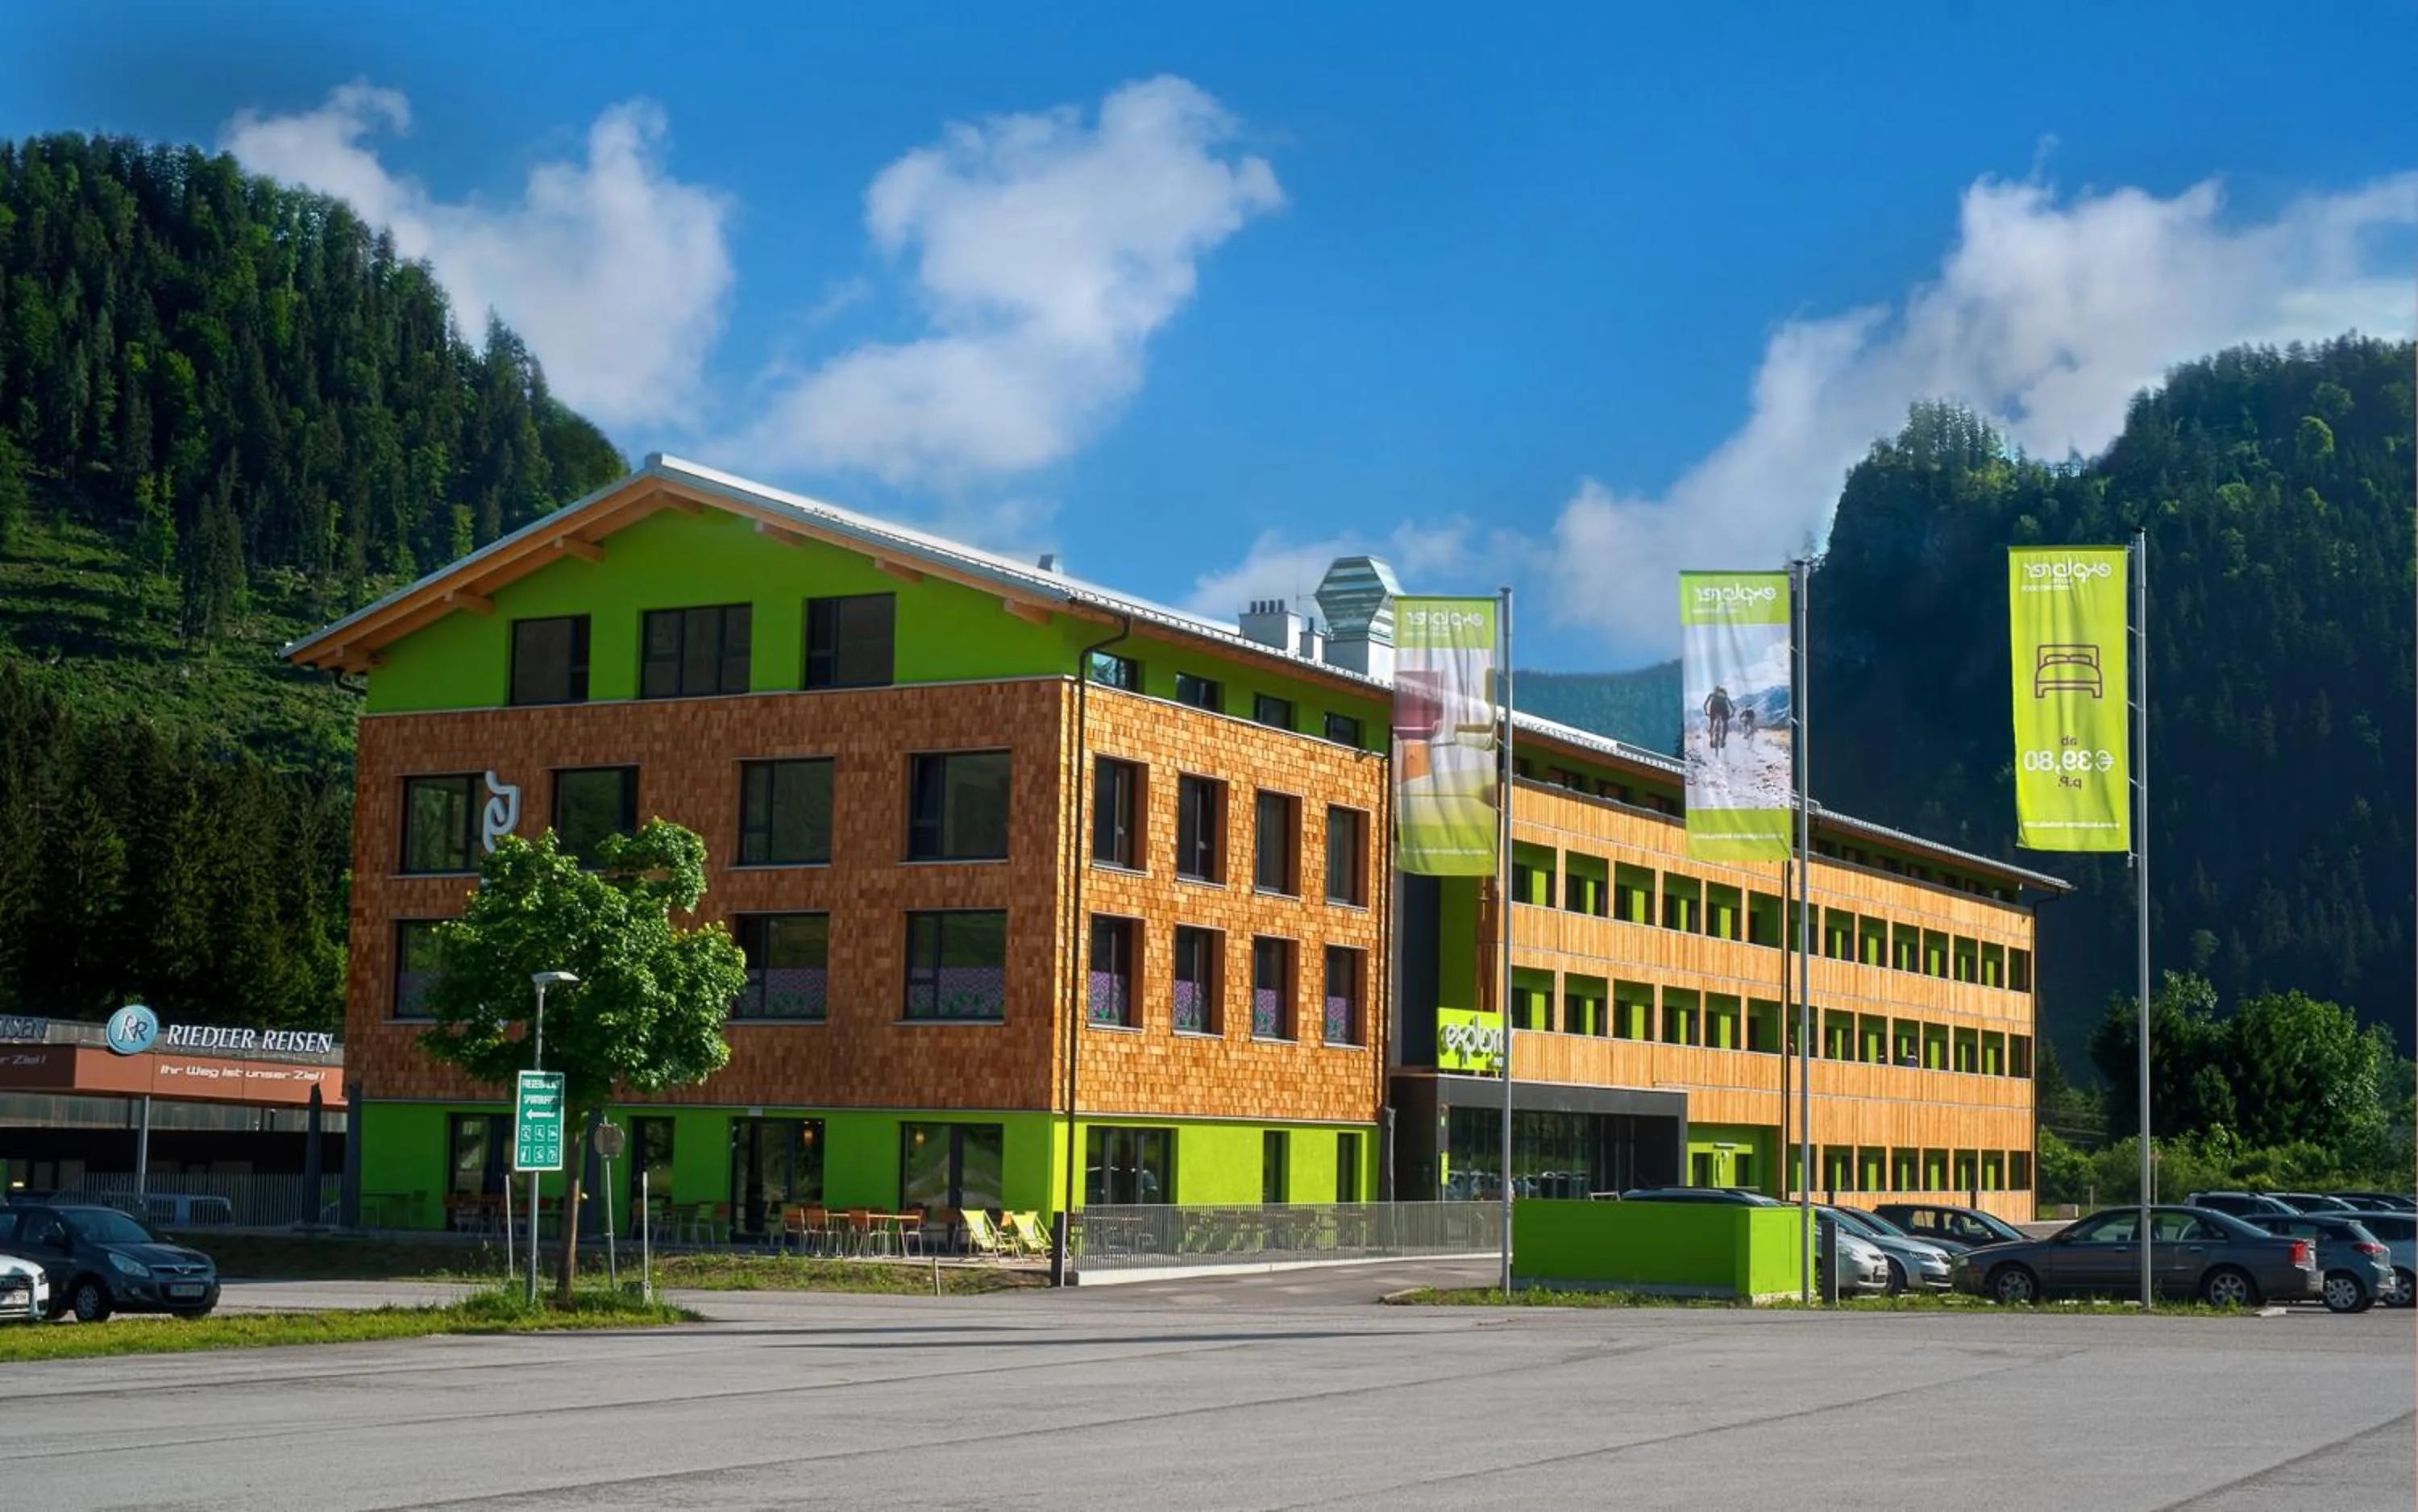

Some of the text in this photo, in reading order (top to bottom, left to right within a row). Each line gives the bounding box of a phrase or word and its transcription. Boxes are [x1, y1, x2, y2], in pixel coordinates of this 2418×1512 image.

[167, 1024, 334, 1054] RIEDLER REISEN
[1445, 1013, 1504, 1064] explor
[160, 1065, 326, 1081] Ihr Weg ist unser Ziel!
